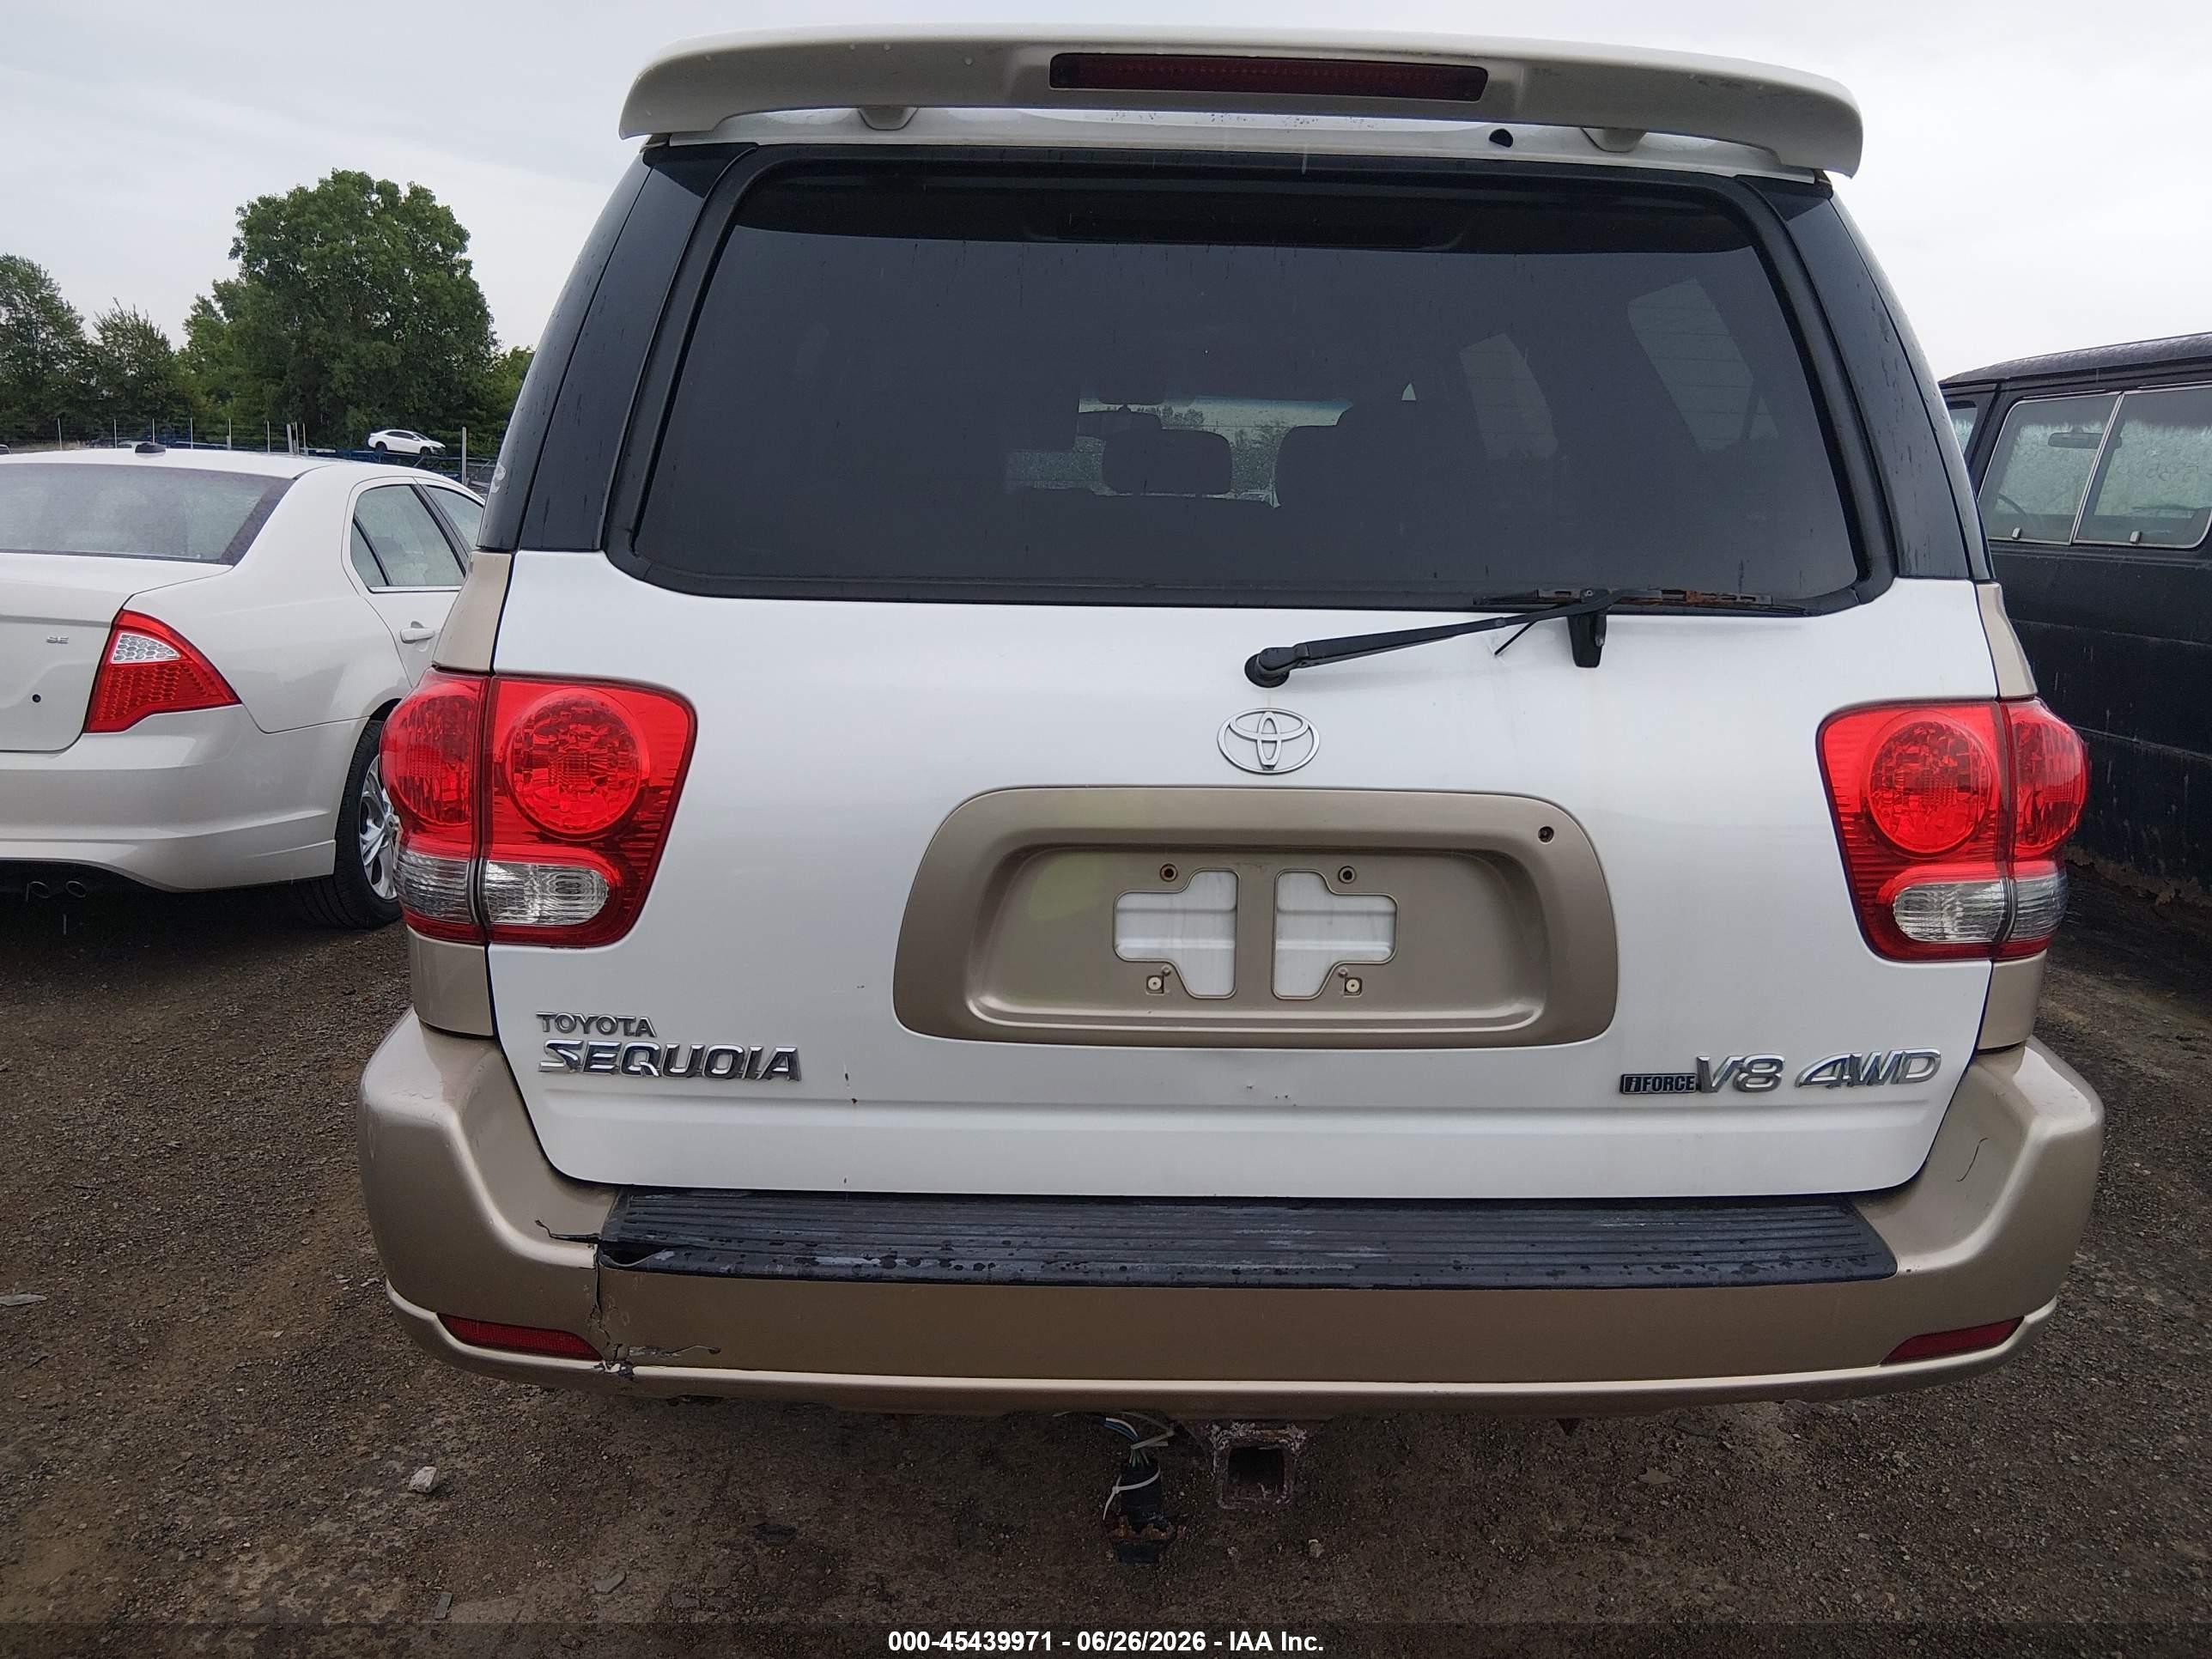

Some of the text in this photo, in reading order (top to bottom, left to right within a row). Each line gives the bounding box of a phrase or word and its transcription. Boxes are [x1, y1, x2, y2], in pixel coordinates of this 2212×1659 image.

[535, 1011, 658, 1038] TOYOTA
[538, 1039, 802, 1082] SEQUOIA
[1696, 1053, 1786, 1093] V8
[1796, 1048, 1942, 1089] 4WD
